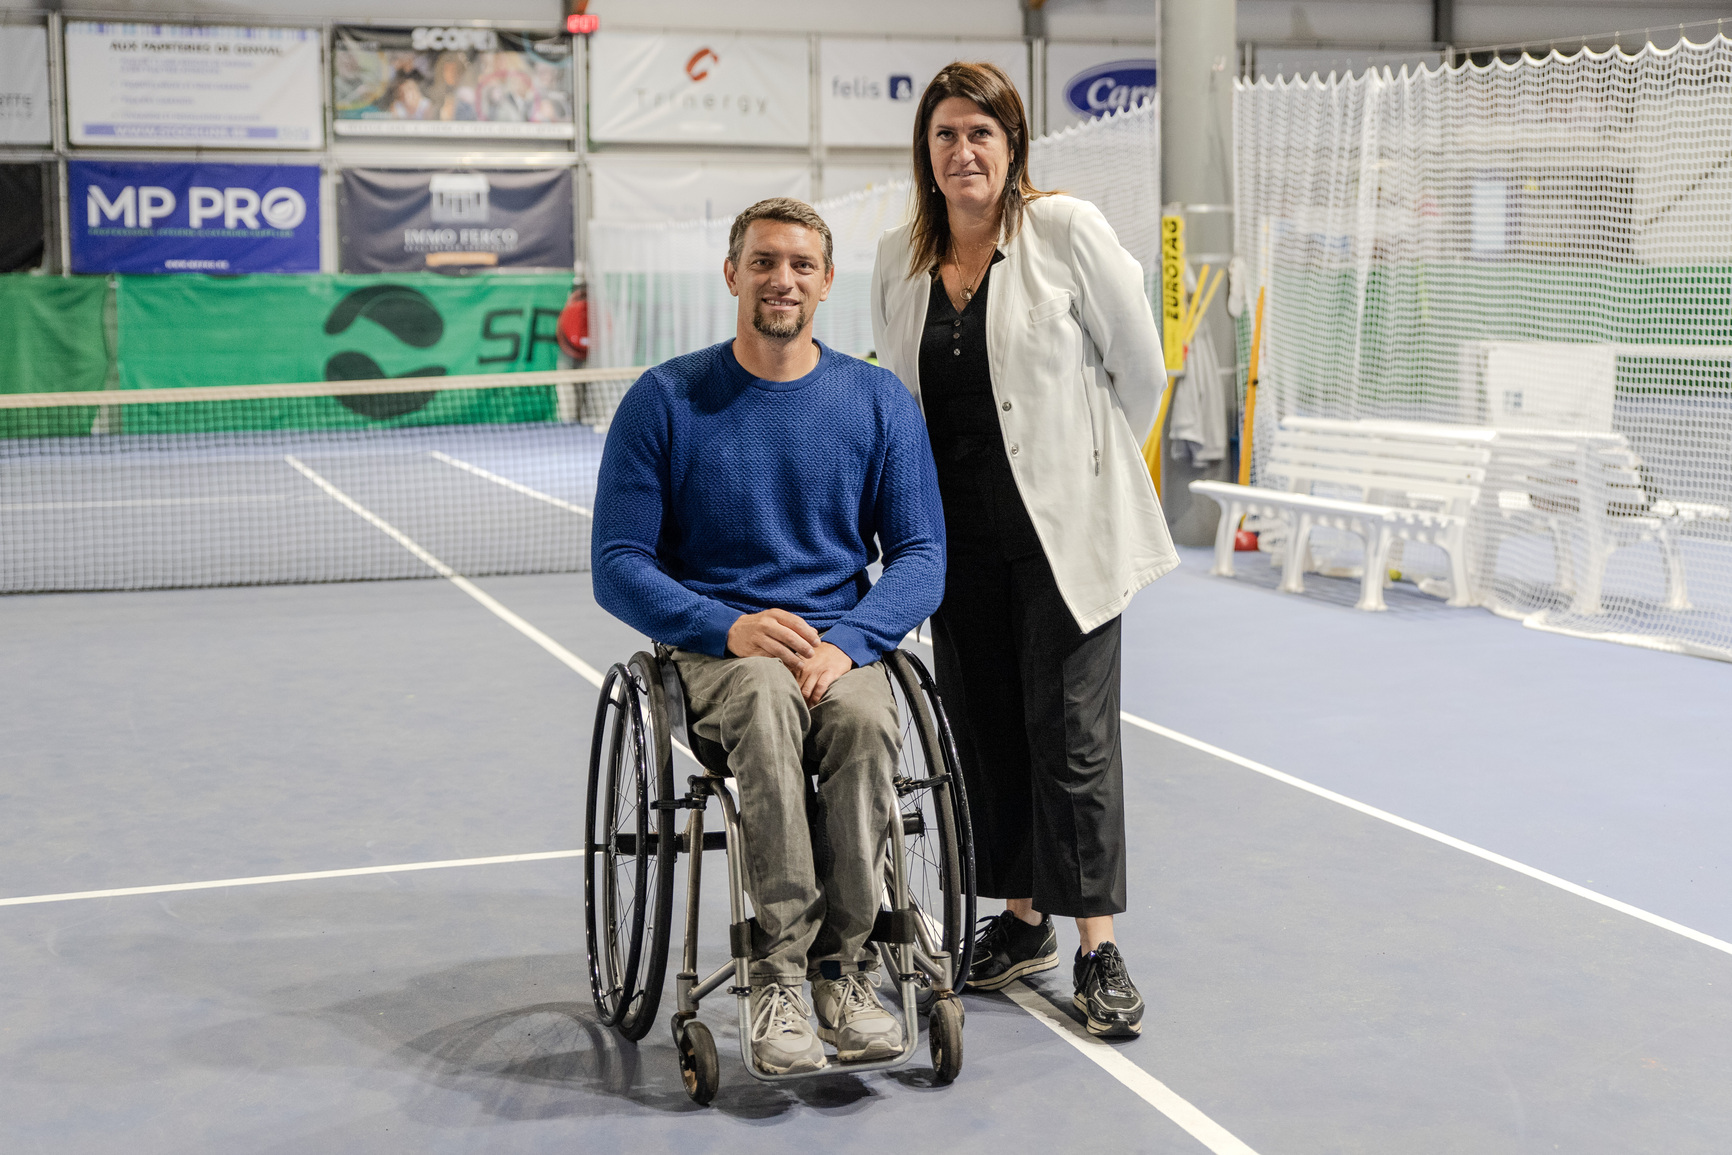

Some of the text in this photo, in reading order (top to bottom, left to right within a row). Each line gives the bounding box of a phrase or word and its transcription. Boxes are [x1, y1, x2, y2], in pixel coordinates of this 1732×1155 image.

[110, 41, 138, 54] AUX
[215, 43, 230, 55] DE
[234, 43, 283, 57] GENVAL
[832, 74, 882, 99] felis
[633, 87, 770, 117] Trinergy
[87, 185, 307, 230] MP PRO
[404, 228, 458, 246] IMMO
